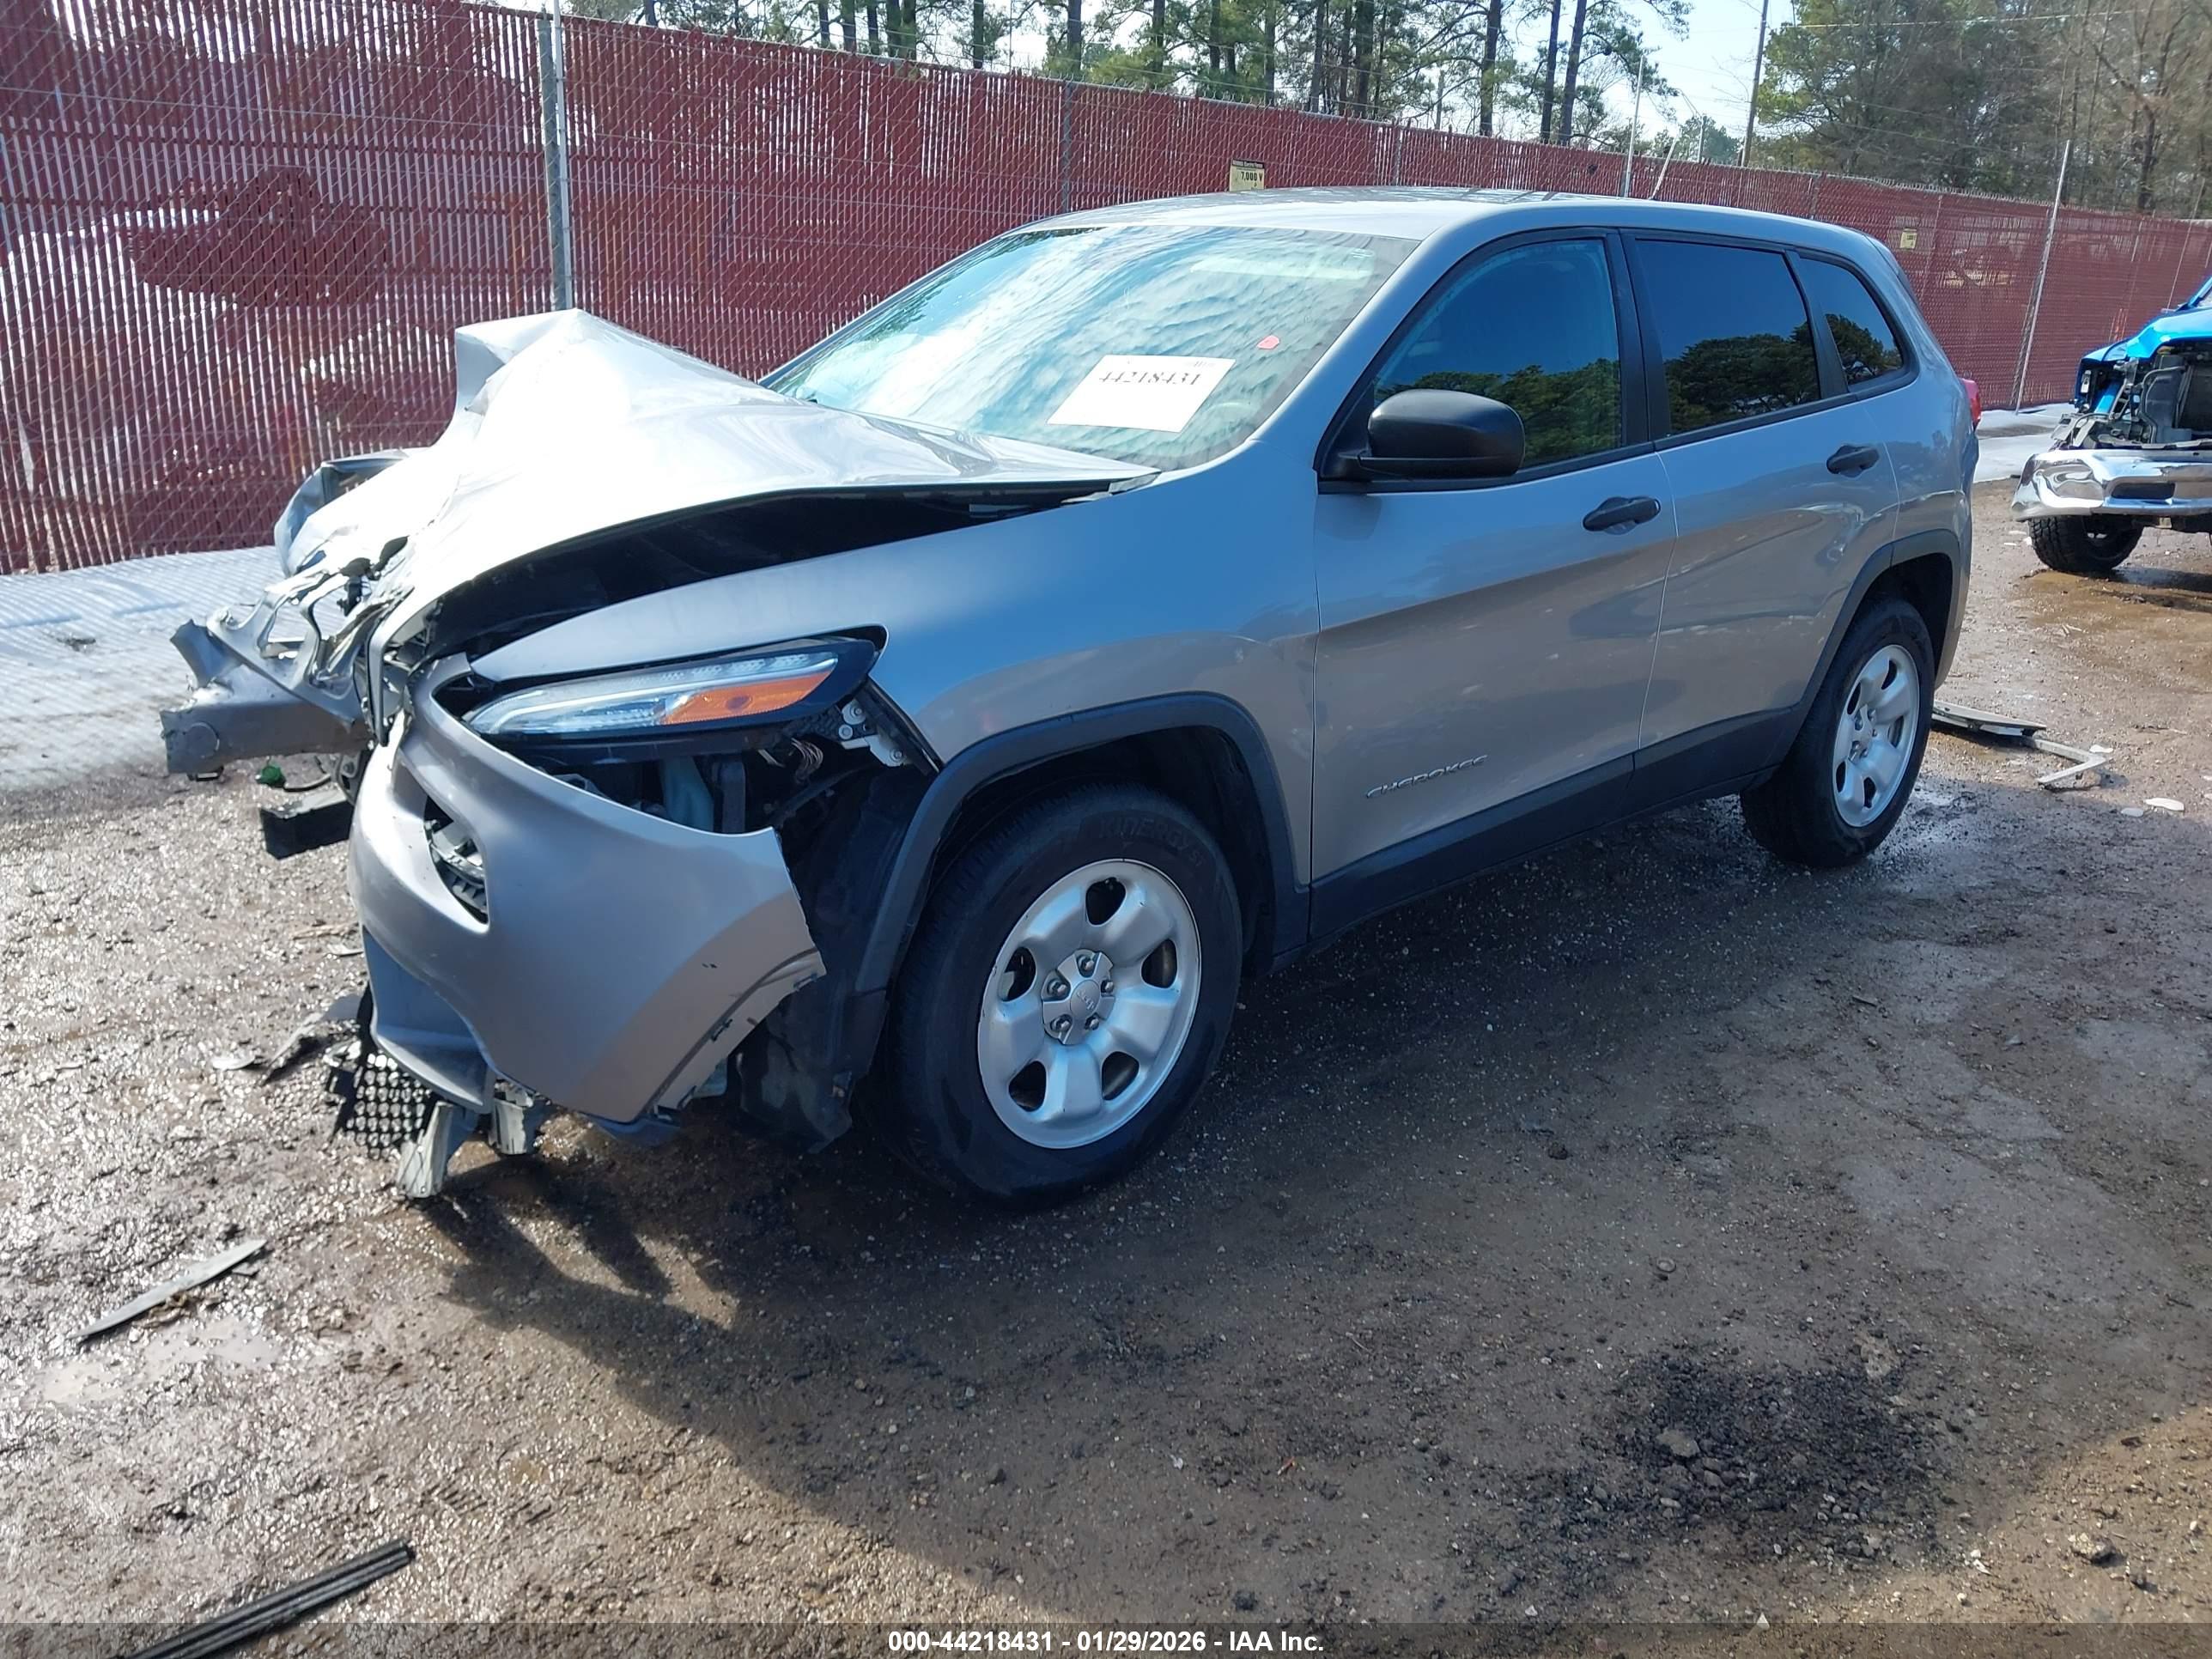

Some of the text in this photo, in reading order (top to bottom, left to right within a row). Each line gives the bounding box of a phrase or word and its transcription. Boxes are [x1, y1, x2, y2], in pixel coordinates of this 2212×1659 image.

[1241, 172, 1263, 181] 7,000 V
[1099, 371, 1201, 385] 44218431
[1366, 755, 1488, 799] CHEROKEE
